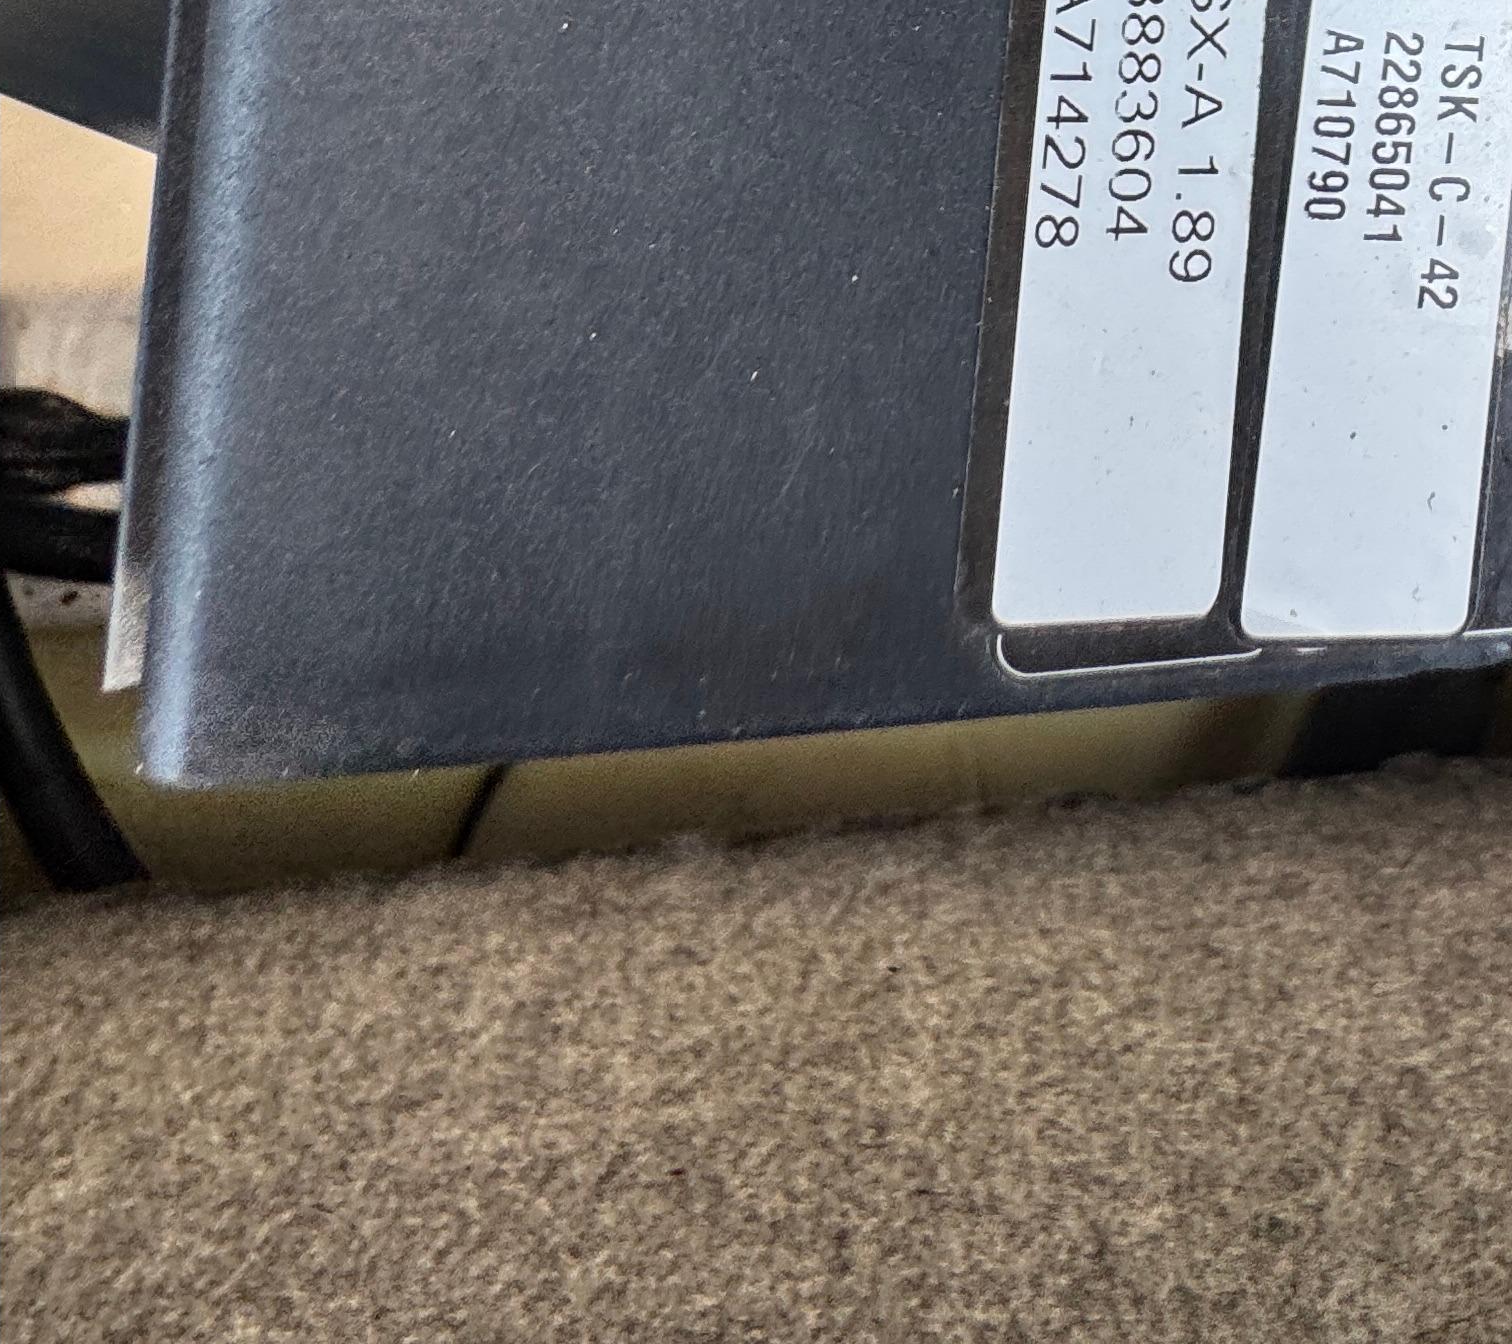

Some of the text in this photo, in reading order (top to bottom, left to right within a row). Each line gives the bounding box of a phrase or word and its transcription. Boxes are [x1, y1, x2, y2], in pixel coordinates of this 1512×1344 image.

[1169, 155, 1221, 283] 1.89
[1306, 30, 1365, 221] A710790
[1364, 31, 1424, 245] 22865041
